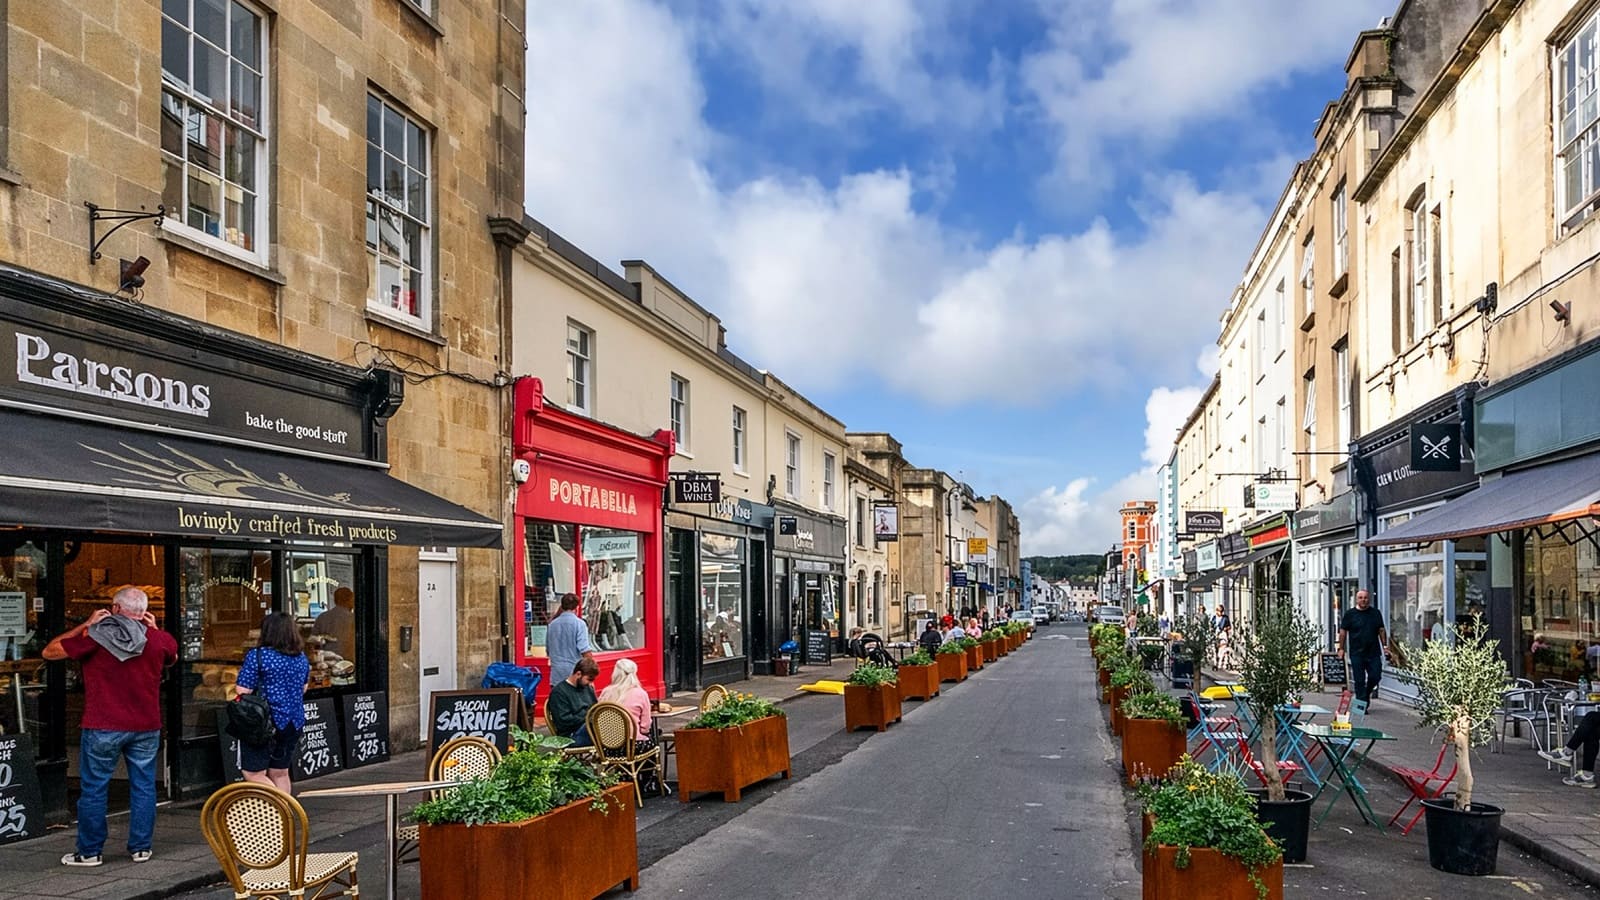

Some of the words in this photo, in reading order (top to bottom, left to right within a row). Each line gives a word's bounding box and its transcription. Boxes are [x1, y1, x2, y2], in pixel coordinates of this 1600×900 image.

[15, 332, 210, 416] Parsons
[245, 412, 273, 430] bake
[275, 418, 294, 434] the
[296, 426, 321, 439] good
[322, 430, 348, 444] stuff
[549, 478, 637, 516] PORTABELLA
[683, 482, 713, 493] DBM
[683, 493, 713, 502] WINES
[177, 507, 242, 534] lovingly
[249, 514, 301, 537] crafted
[307, 518, 344, 537] fresh
[348, 523, 398, 542] products
[454, 700, 489, 711] BACON
[437, 709, 507, 731] SARNIE
